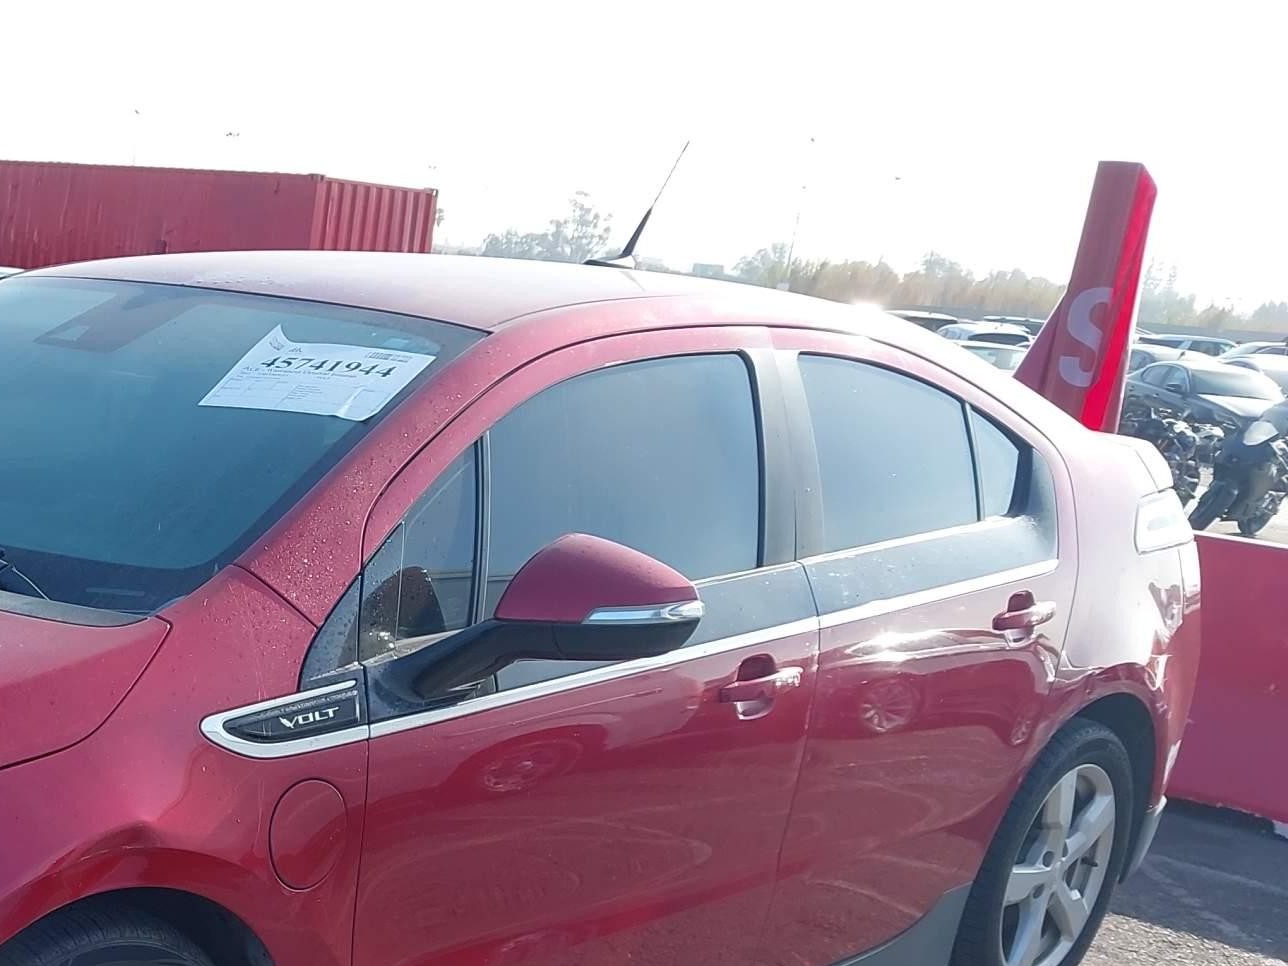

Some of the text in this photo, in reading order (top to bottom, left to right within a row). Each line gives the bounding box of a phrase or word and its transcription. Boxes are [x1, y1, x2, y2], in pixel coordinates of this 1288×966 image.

[1059, 288, 1113, 387] S
[262, 356, 396, 377] 45741944
[279, 707, 339, 729] VOLT
